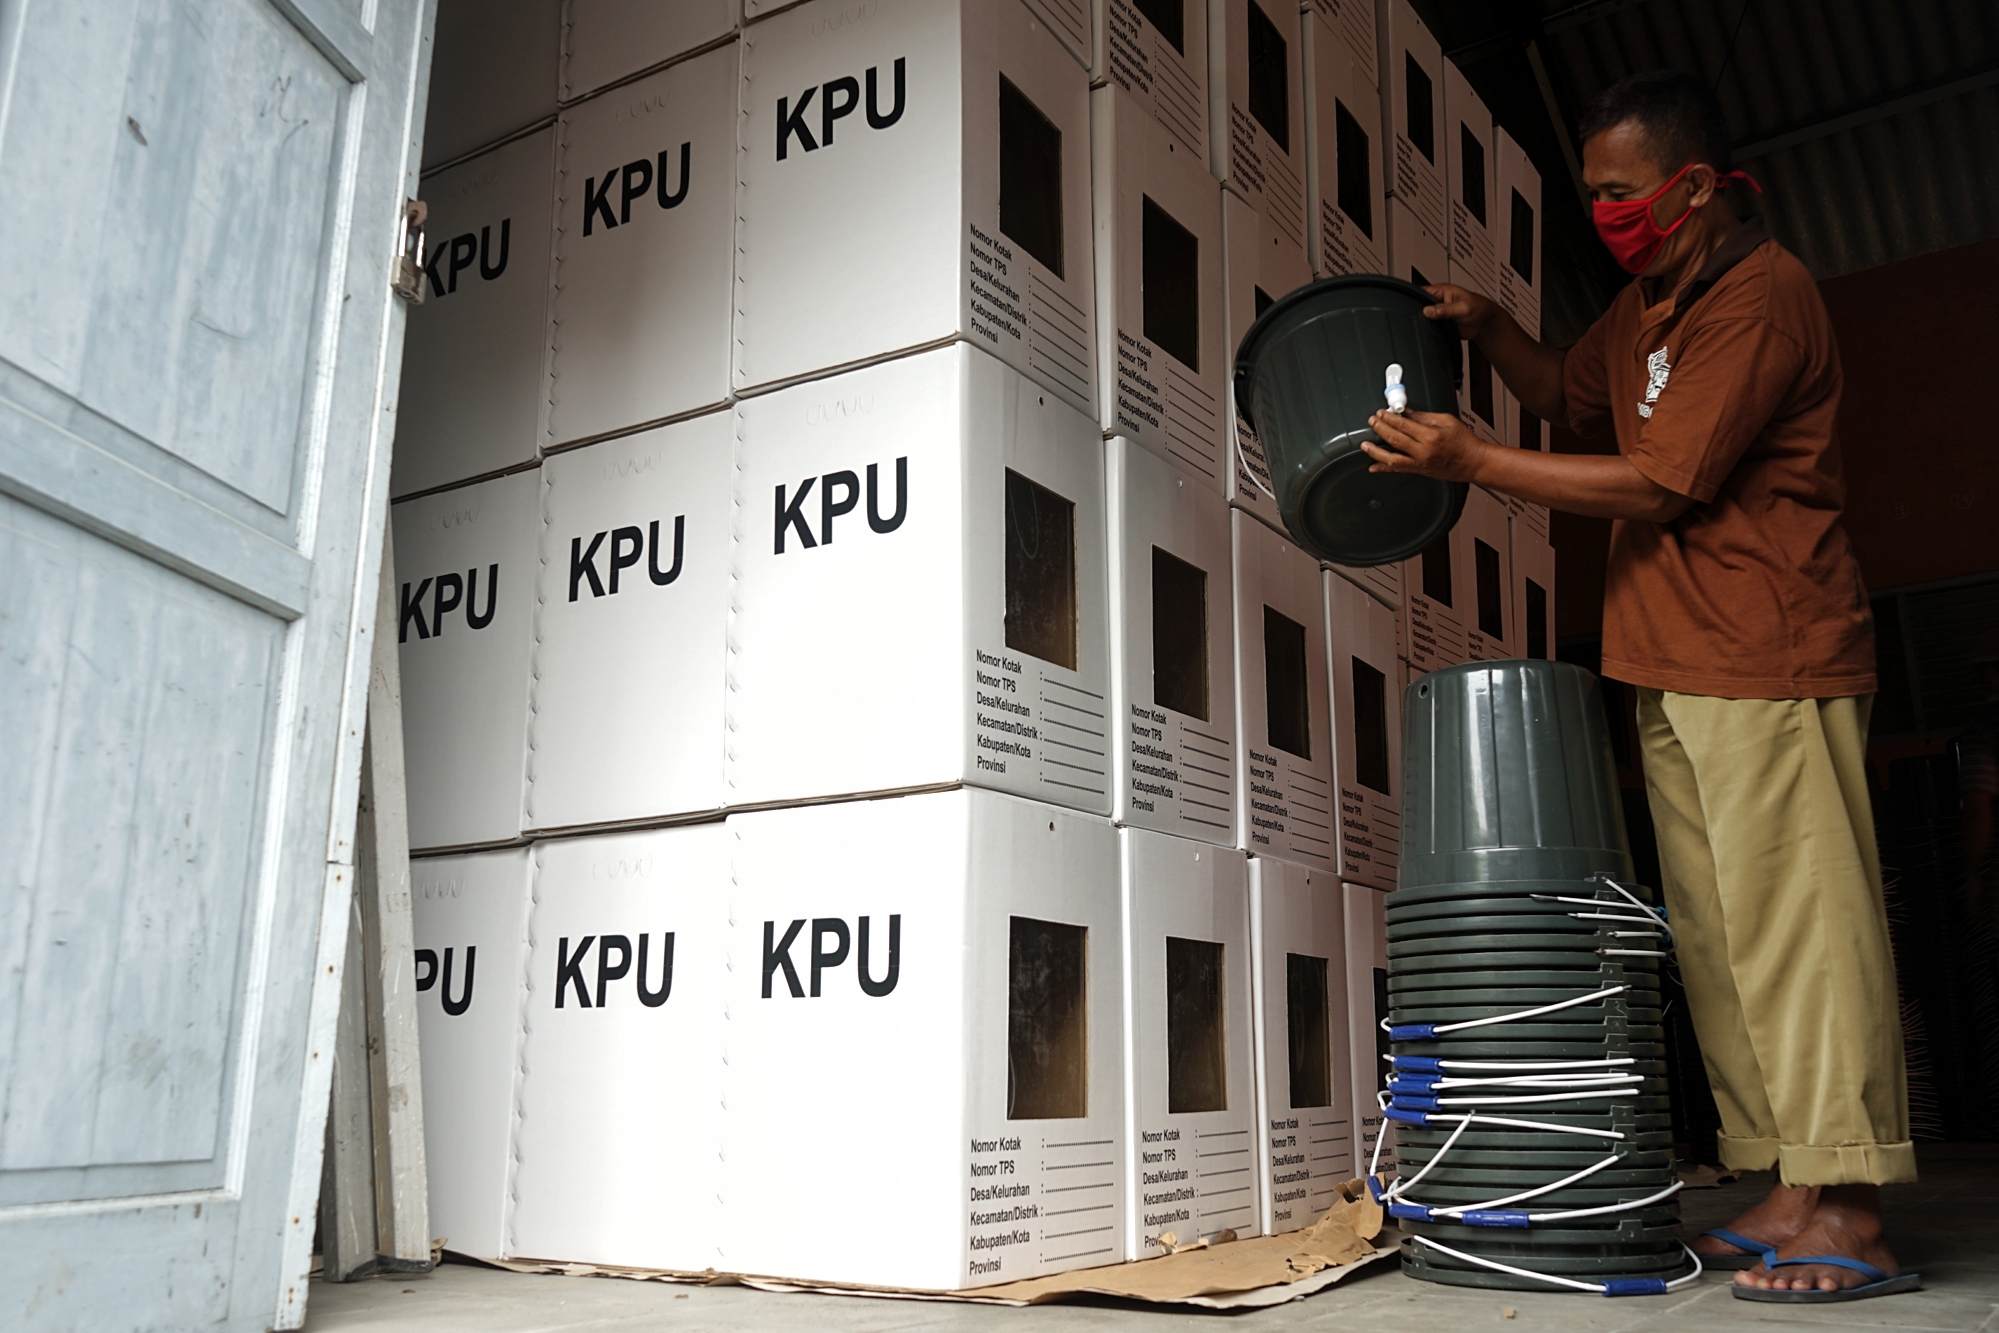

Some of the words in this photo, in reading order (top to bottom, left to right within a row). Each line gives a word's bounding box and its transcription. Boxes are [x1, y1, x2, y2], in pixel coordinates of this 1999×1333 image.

[1110, 5, 1127, 28] Nomor
[1128, 22, 1138, 39] TPS
[1112, 0, 1127, 13] omor
[1128, 8, 1142, 28] Kotak
[1110, 66, 1130, 92] Provinsi
[776, 57, 906, 161] KPU
[582, 141, 691, 238] KPU
[971, 223, 992, 248] Nomor
[994, 239, 1012, 262] Kotak
[423, 218, 511, 298] KPU
[971, 242, 992, 265] Nomor
[994, 258, 1007, 276] TPS
[971, 261, 1020, 303] Desa/Kelurahan
[971, 279, 1027, 326] Kecamatan/Distrik
[971, 298, 1021, 340] Kabupaten/Kota
[971, 317, 998, 344] Provinsi
[1118, 328, 1135, 348] Nomor
[1136, 340, 1152, 358] Kotak
[1118, 345, 1136, 365] Nomor
[1137, 357, 1147, 372] TPS
[1118, 361, 1158, 395] Desa/Kelurahan
[1118, 378, 1164, 415] Kecamatan/Distrik
[1118, 395, 1158, 428] Kabupaten/Kota
[1118, 412, 1139, 433] Provinsi
[774, 456, 908, 555] KPU
[568, 514, 686, 602] KPU
[398, 563, 498, 644] KPU
[977, 649, 1000, 670] Nomor
[1002, 657, 1022, 674] Kotak
[977, 670, 1000, 691] Nomor
[1002, 677, 1016, 692] TPS
[977, 691, 1030, 717] Desa/Kelurahan
[1132, 704, 1150, 720] Nomor
[1151, 709, 1166, 725] Kotak
[977, 712, 1038, 739] Kecamatan/Distrik
[1132, 722, 1150, 738] Nomor
[1151, 728, 1162, 741] TPS
[977, 734, 1031, 758] Kabupaten/Kota
[1132, 741, 1172, 762] Desa/Kelurahan
[977, 755, 1006, 773] Provinsi
[1250, 749, 1264, 763] Nomor
[1265, 754, 1277, 767] Kotak
[1132, 759, 1178, 782] Kecamatan/Distrik
[1250, 765, 1265, 779] Nomor
[1265, 770, 1274, 782] TPS
[1132, 778, 1173, 798] Kabupaten/Kota
[1251, 782, 1283, 800] Desa/Kelurahan
[1132, 797, 1154, 812] Provinsi
[1251, 798, 1288, 817] Kecamatan/Distrik
[1252, 815, 1284, 832] Kabupaten/Kota
[1252, 832, 1269, 845] Provinsi
[762, 914, 902, 999] KPU
[554, 932, 675, 1008] KPU
[414, 946, 476, 1016] PU
[1271, 1120, 1286, 1130] Nomor
[1287, 1118, 1299, 1129] Kotak
[971, 1139, 997, 1153] Nomor
[1000, 1137, 1021, 1151] Kotak
[1142, 1131, 1162, 1143] Nomor
[1164, 1128, 1180, 1141] Kotak
[1272, 1138, 1286, 1148] Nomor
[1287, 1136, 1296, 1146] TPS
[1143, 1152, 1162, 1164] Nomor
[1164, 1149, 1176, 1162] TPS
[1273, 1153, 1304, 1167] Desa/Kelurahan
[971, 1163, 997, 1177] Nomor
[999, 1160, 1014, 1174] TPS
[1143, 1168, 1188, 1185] Desa/Kelurahan
[1274, 1169, 1309, 1185] Kecamatan/Distrik
[971, 1183, 1030, 1201] Desa/Kelurahan
[1144, 1187, 1195, 1206] Kecamatan/Distrik
[1274, 1188, 1306, 1204] Kabupaten/Kota
[971, 1205, 1038, 1226] Kecamatan/Distrik
[1144, 1209, 1189, 1227] Kabupaten/Kota
[1275, 1208, 1292, 1222] Provinsi
[970, 1230, 1030, 1251] Kabupaten/Kota
[1145, 1233, 1160, 1248] Provi
[970, 1256, 1001, 1275] Provinsi
